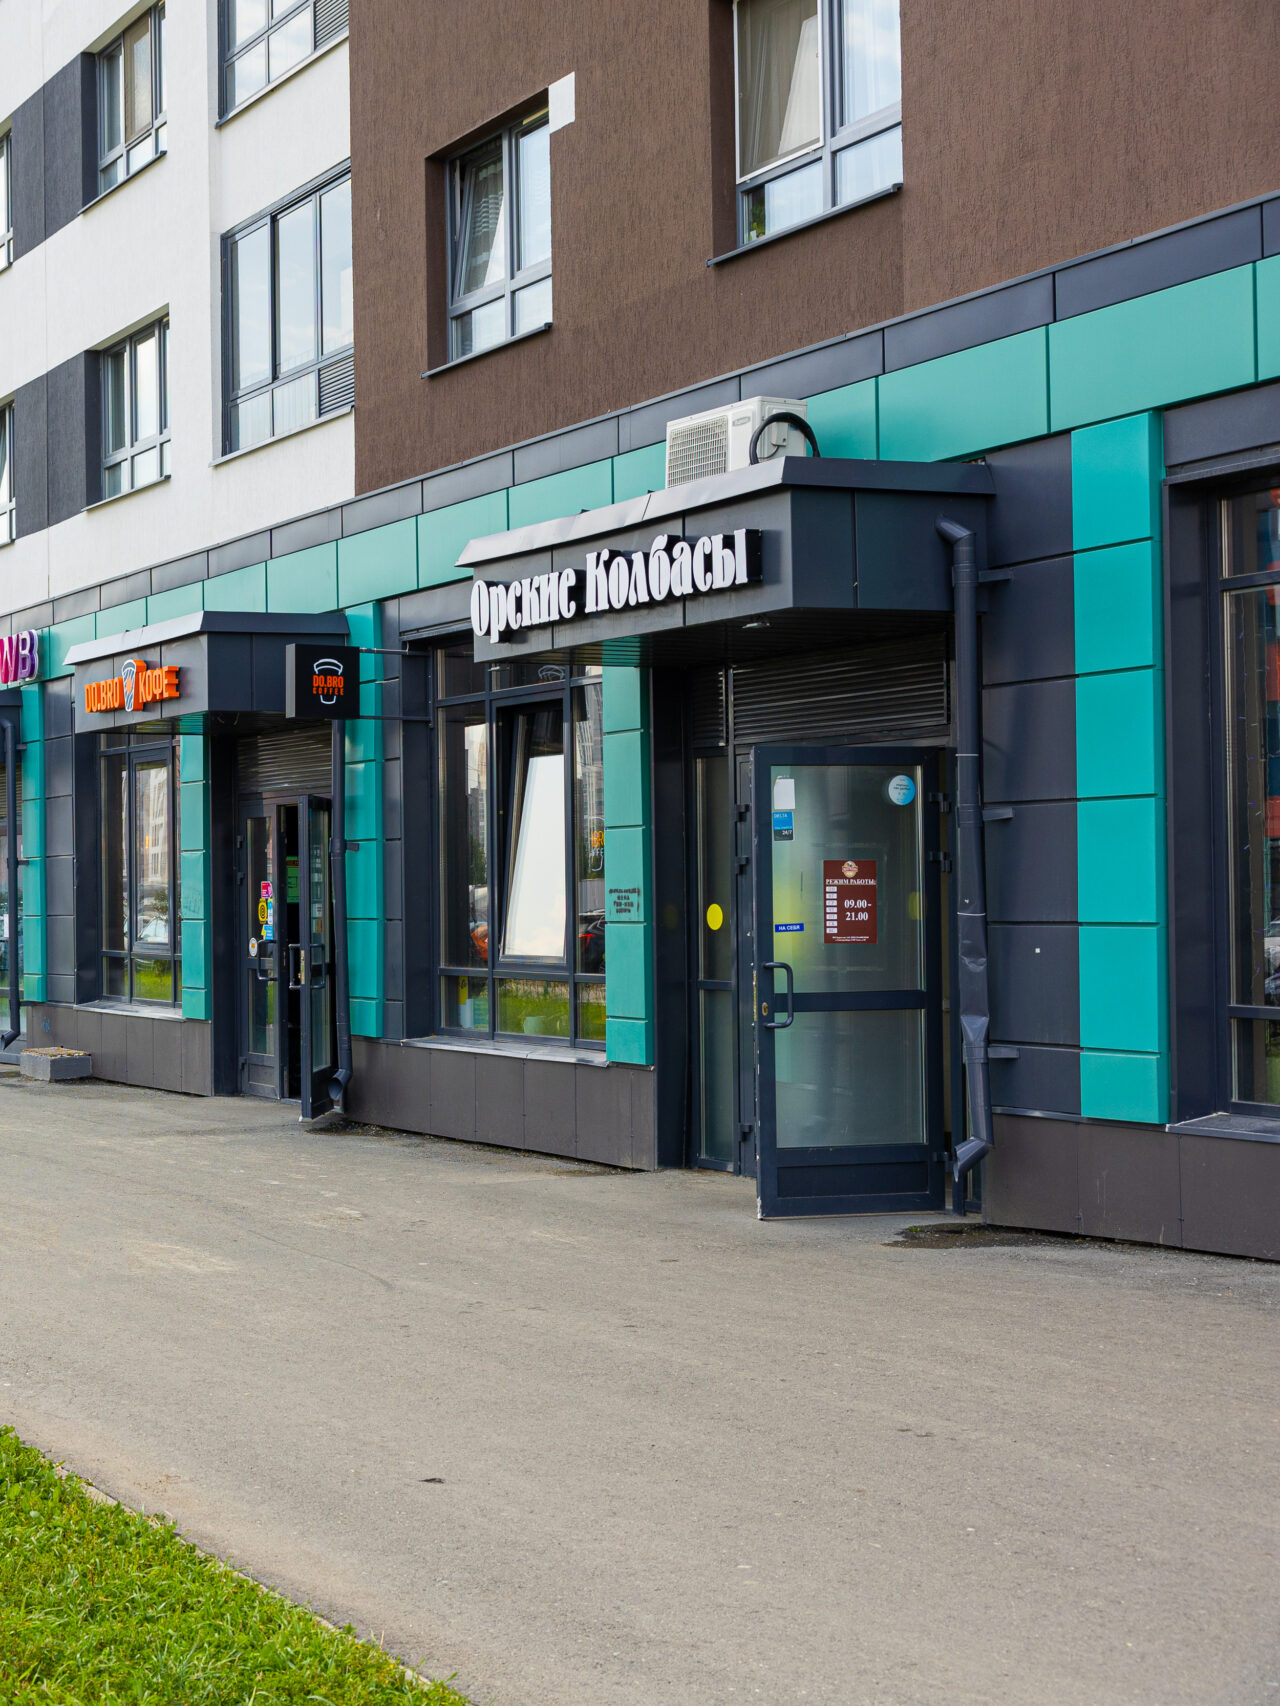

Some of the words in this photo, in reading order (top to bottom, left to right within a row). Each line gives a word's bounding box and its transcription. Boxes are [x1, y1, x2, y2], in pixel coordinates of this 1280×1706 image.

[470, 567, 577, 644] Орские
[585, 528, 754, 614] Колбасы
[312, 675, 344, 688] DO.BRO
[85, 677, 124, 714] DO.BRO
[139, 666, 178, 703] КОФЕ
[312, 687, 344, 695] COFFEE
[825, 878, 849, 886] РЕЖИМ
[850, 878, 877, 886] РАБОТЫ:
[845, 911, 869, 921] 21.00
